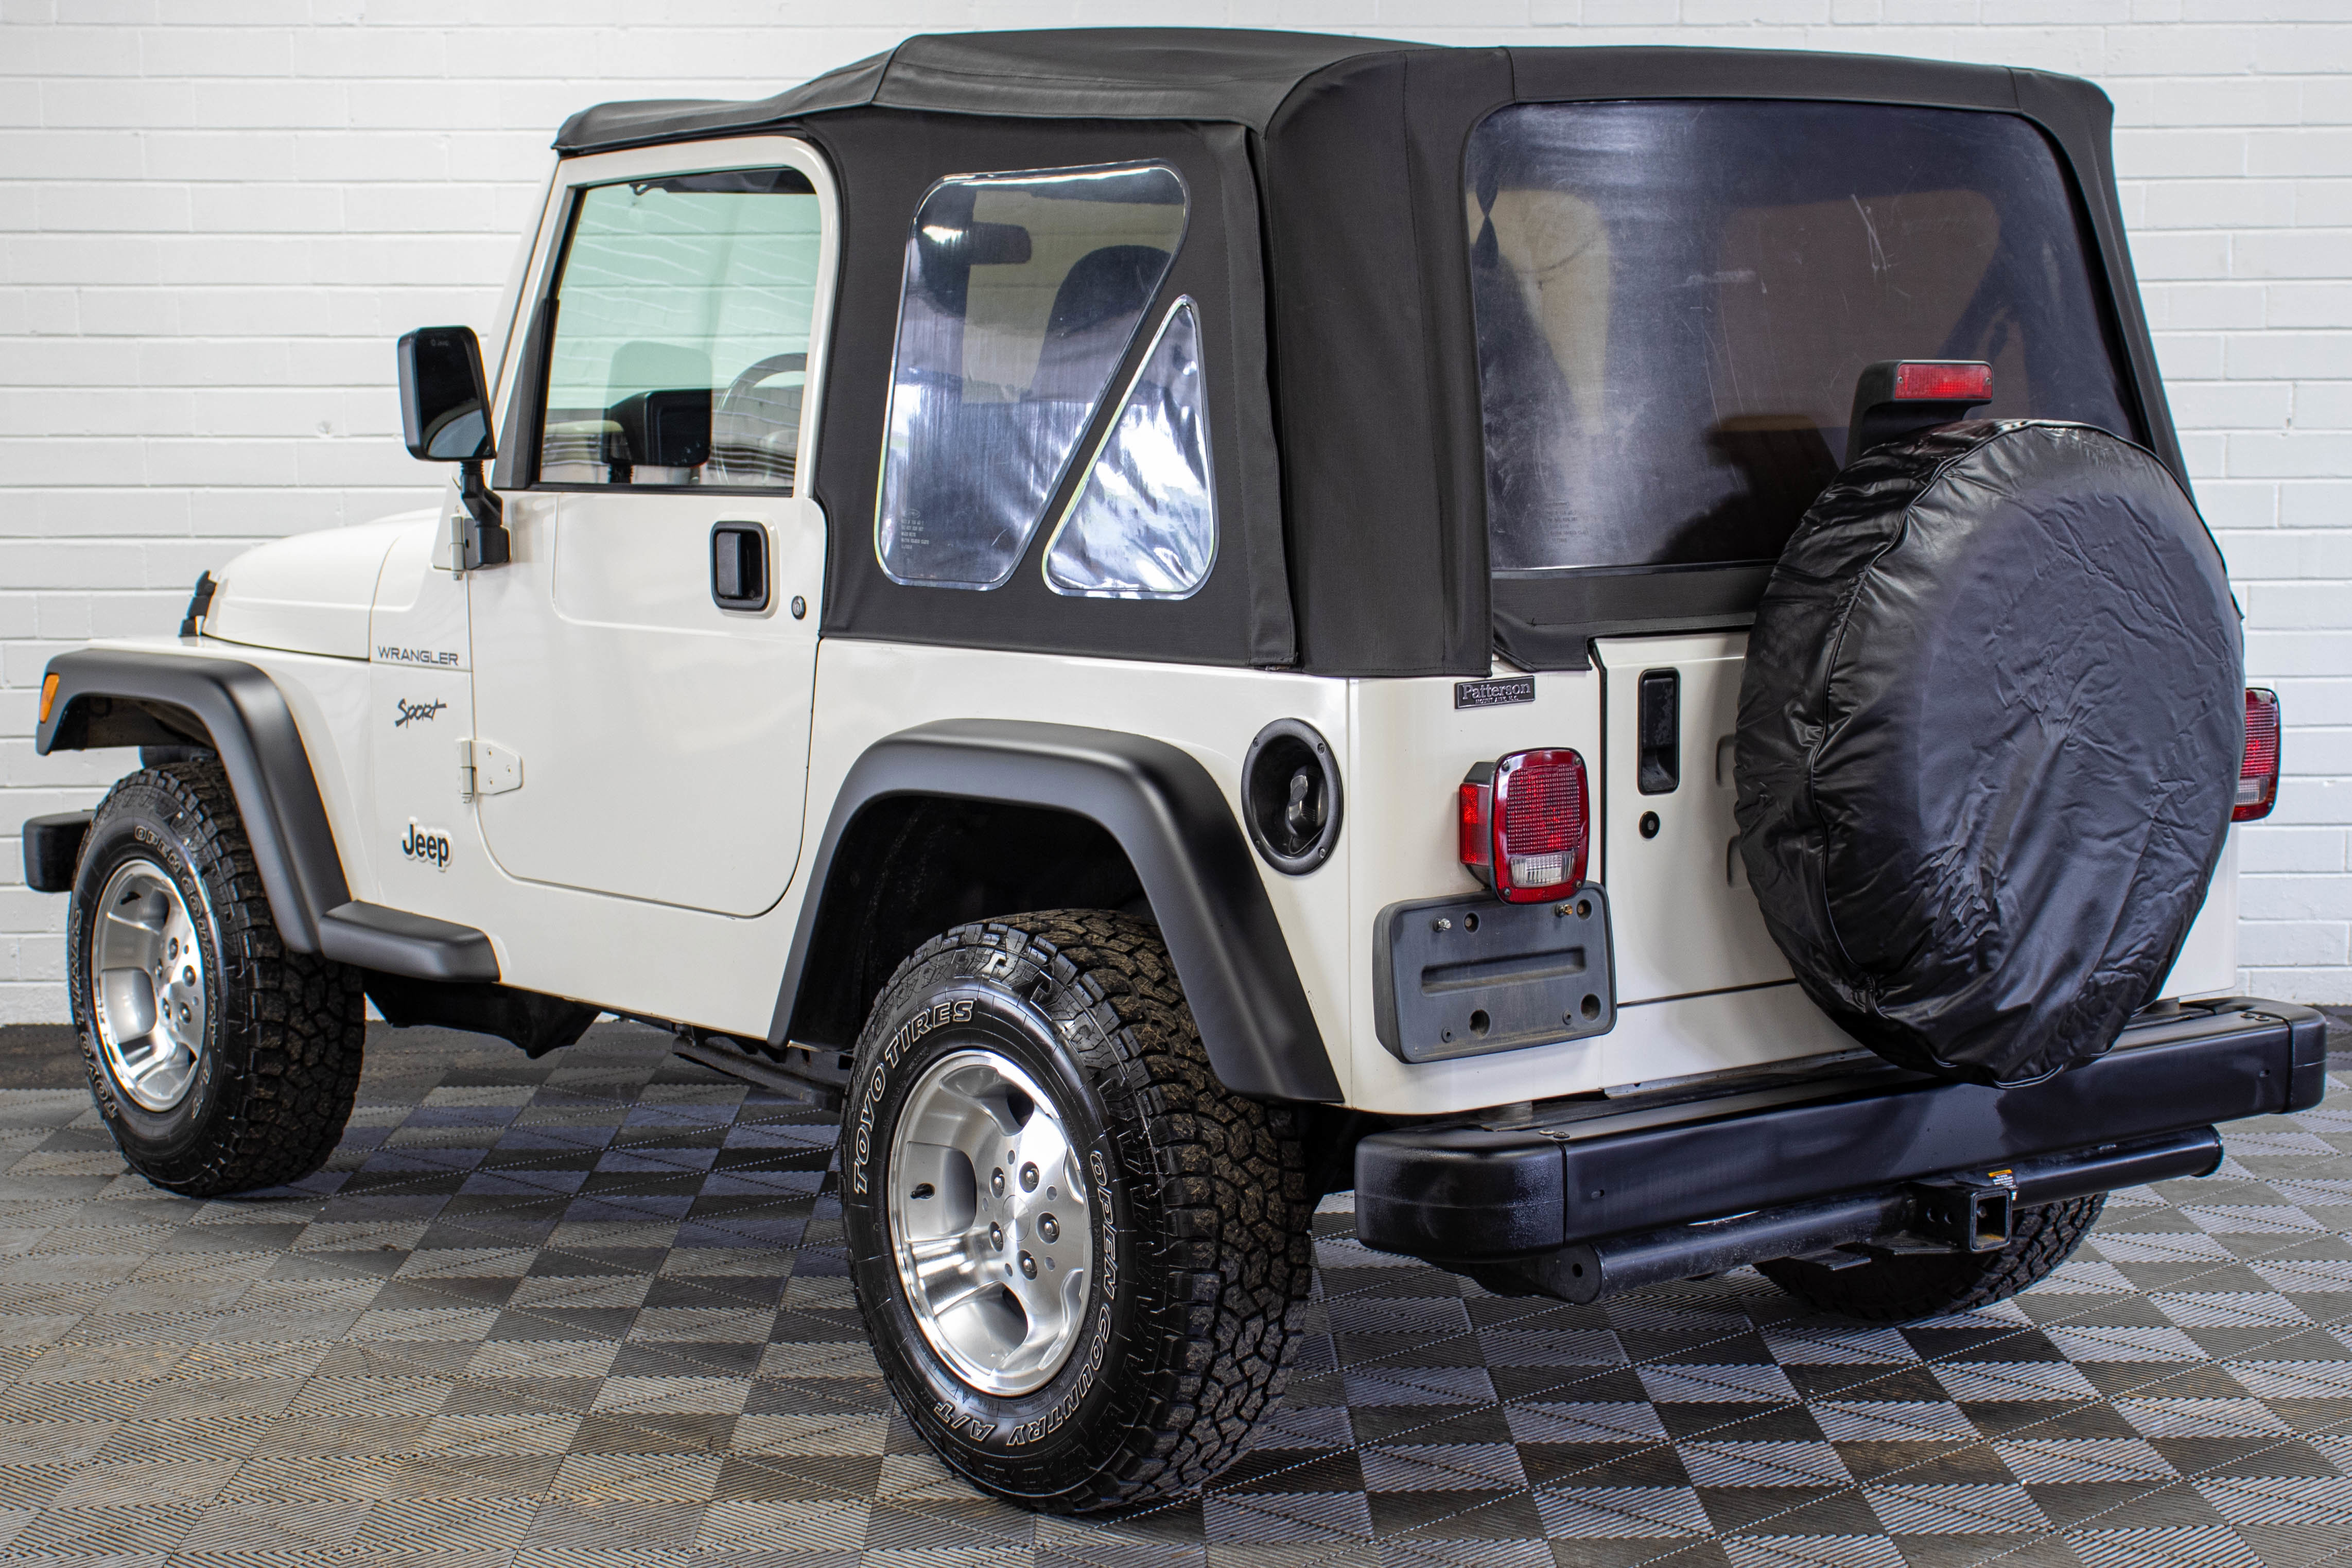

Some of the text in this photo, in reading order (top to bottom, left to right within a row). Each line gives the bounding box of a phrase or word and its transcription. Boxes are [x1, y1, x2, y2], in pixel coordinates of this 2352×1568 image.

[377, 645, 459, 666] WRANGLER
[395, 698, 447, 728] Sport
[1462, 683, 1531, 700] Patterson
[134, 825, 181, 873] OPEN
[402, 823, 450, 869] Jeep
[79, 1032, 119, 1120] TOYO
[853, 1065, 886, 1195] TOYO
[884, 999, 975, 1069] TIRES
[1090, 1151, 1117, 1300] OPEN
[1005, 1305, 1111, 1447] COUNTRY
[933, 1402, 997, 1442] A/T
